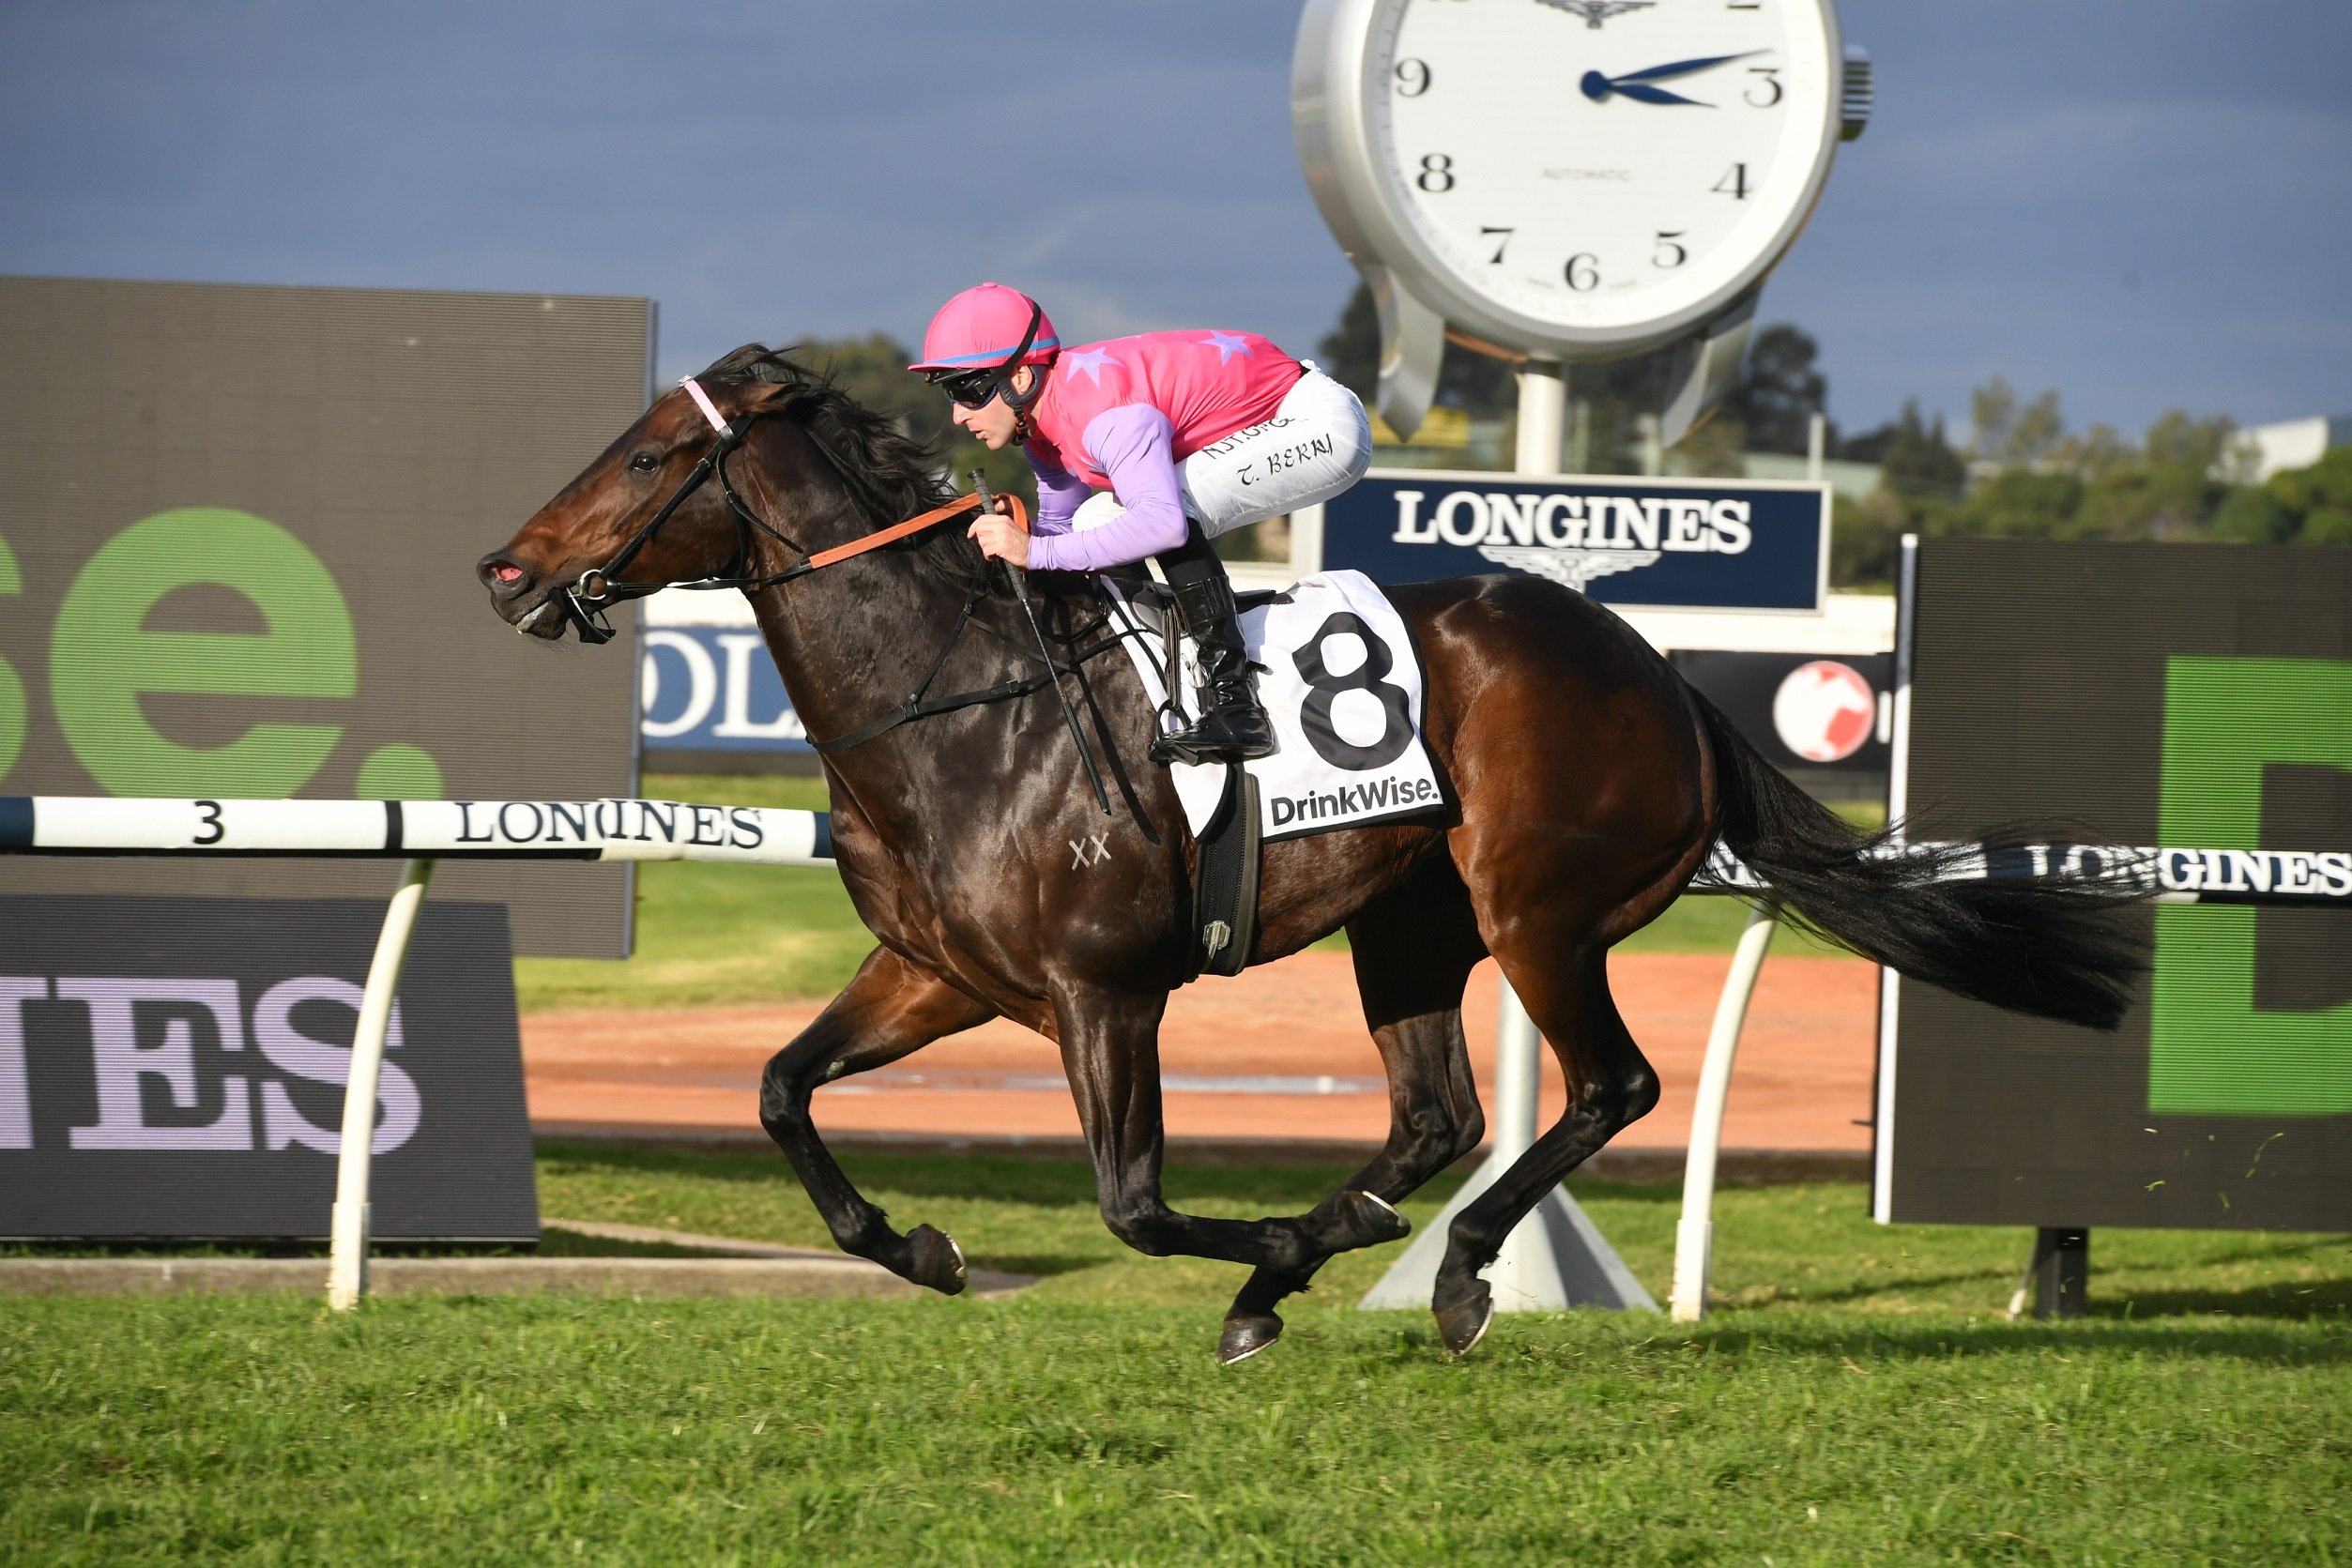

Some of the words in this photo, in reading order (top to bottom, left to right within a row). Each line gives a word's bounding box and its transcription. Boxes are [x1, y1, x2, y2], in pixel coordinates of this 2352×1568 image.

[1395, 57, 1432, 98] 9
[1743, 67, 1783, 108] 3
[1416, 153, 1456, 193] 8
[1710, 162, 1752, 201] 4
[1479, 226, 1515, 265] 7
[1651, 231, 1688, 268] 5
[1563, 252, 1600, 292] 6
[1392, 490, 1753, 555] LONGINES
[1291, 611, 1414, 771] 8
[1271, 776, 1439, 826] DrinkWise.
[192, 800, 224, 844] 3
